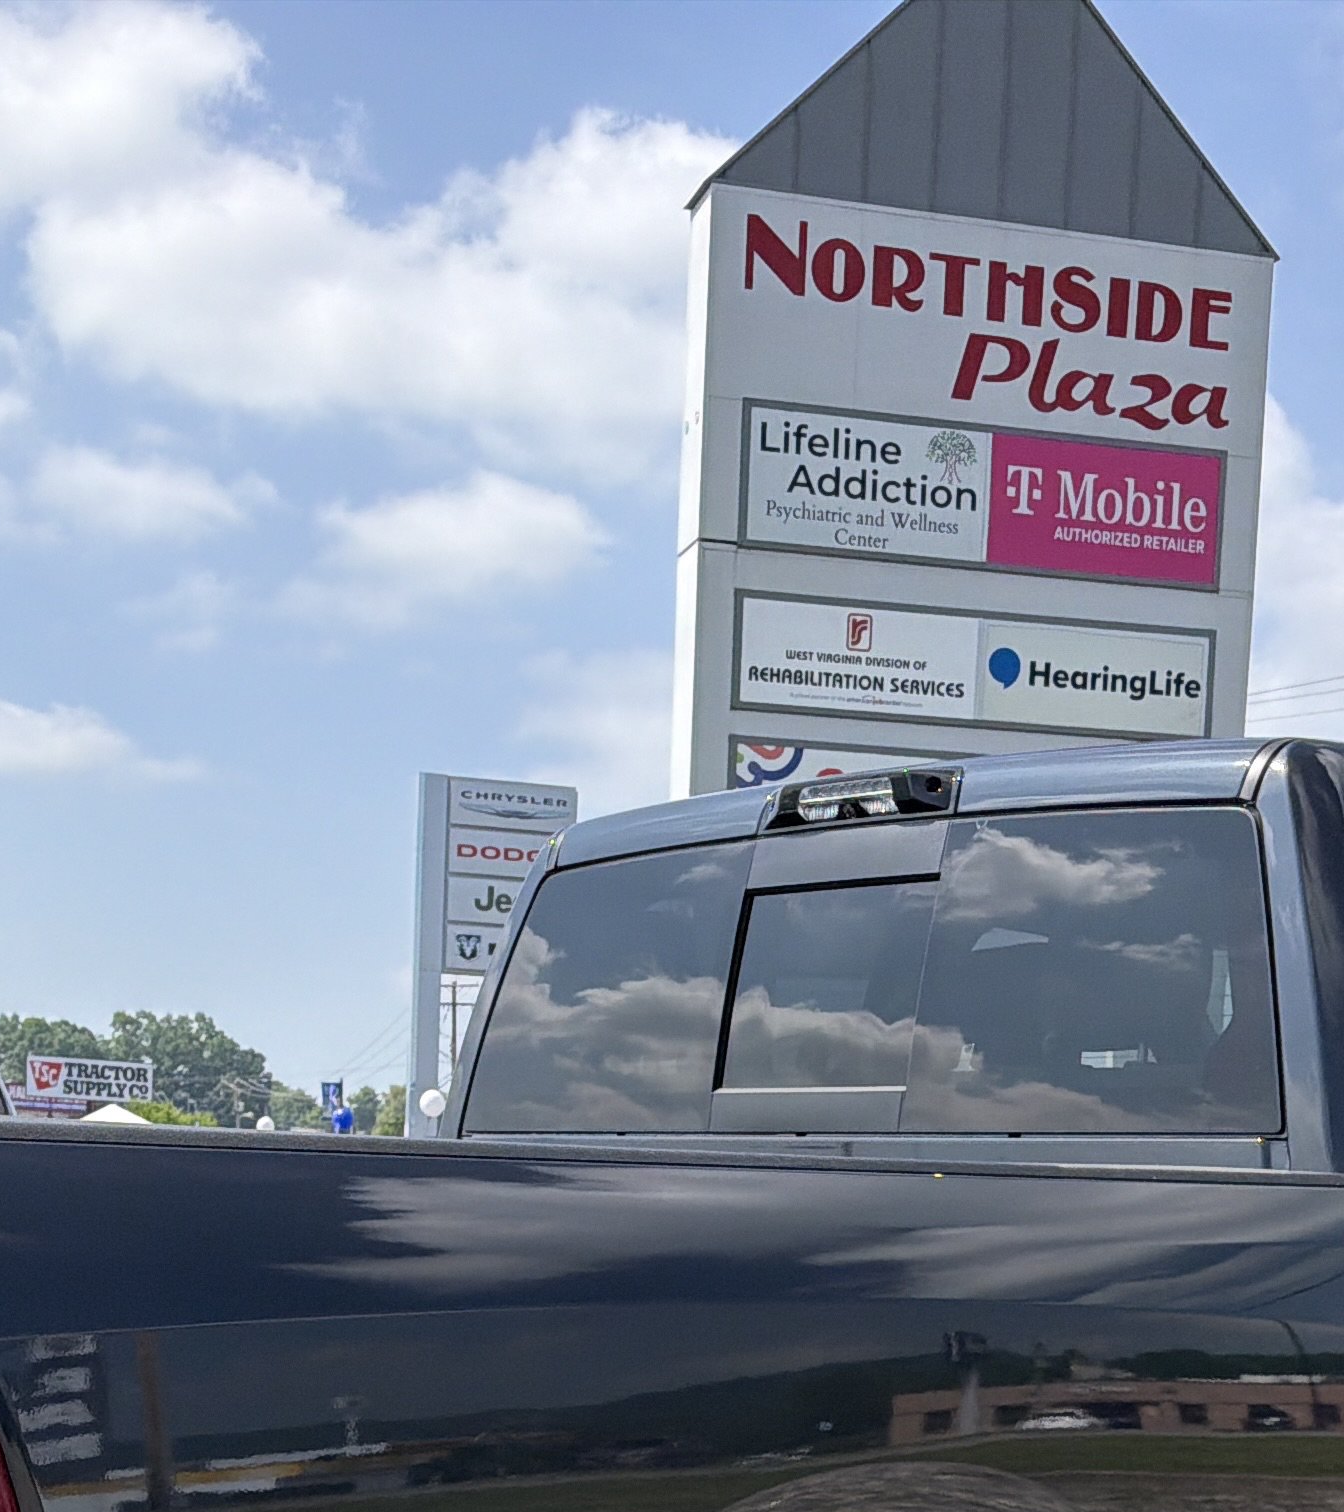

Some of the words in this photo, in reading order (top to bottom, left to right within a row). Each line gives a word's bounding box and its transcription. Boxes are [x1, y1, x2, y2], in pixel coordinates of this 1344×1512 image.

[744, 213, 1233, 351] NORTHSIDE
[950, 332, 1231, 431] Plaza
[760, 421, 902, 465] Lifeline
[786, 464, 977, 512] Addiction
[1054, 469, 1207, 533] Mobile
[765, 500, 852, 524] Psychiatric
[855, 509, 885, 528] and
[890, 512, 960, 535] Wellness
[833, 527, 890, 550] Center
[1053, 526, 1141, 549] AUTHORIZED
[1143, 536, 1205, 554] RETAILER
[785, 650, 814, 661] WEST
[816, 652, 863, 666] VIRGINIA
[865, 657, 910, 670] DIVISION
[913, 660, 928, 671] OF
[748, 666, 885, 692] REHABILITATION
[890, 677, 966, 699] SERVICES
[1028, 660, 1202, 701] HearingLife
[460, 790, 569, 808] CHRYSLER
[62, 1079, 127, 1099] SUPPLY
[64, 1062, 149, 1083] TRACTOR
